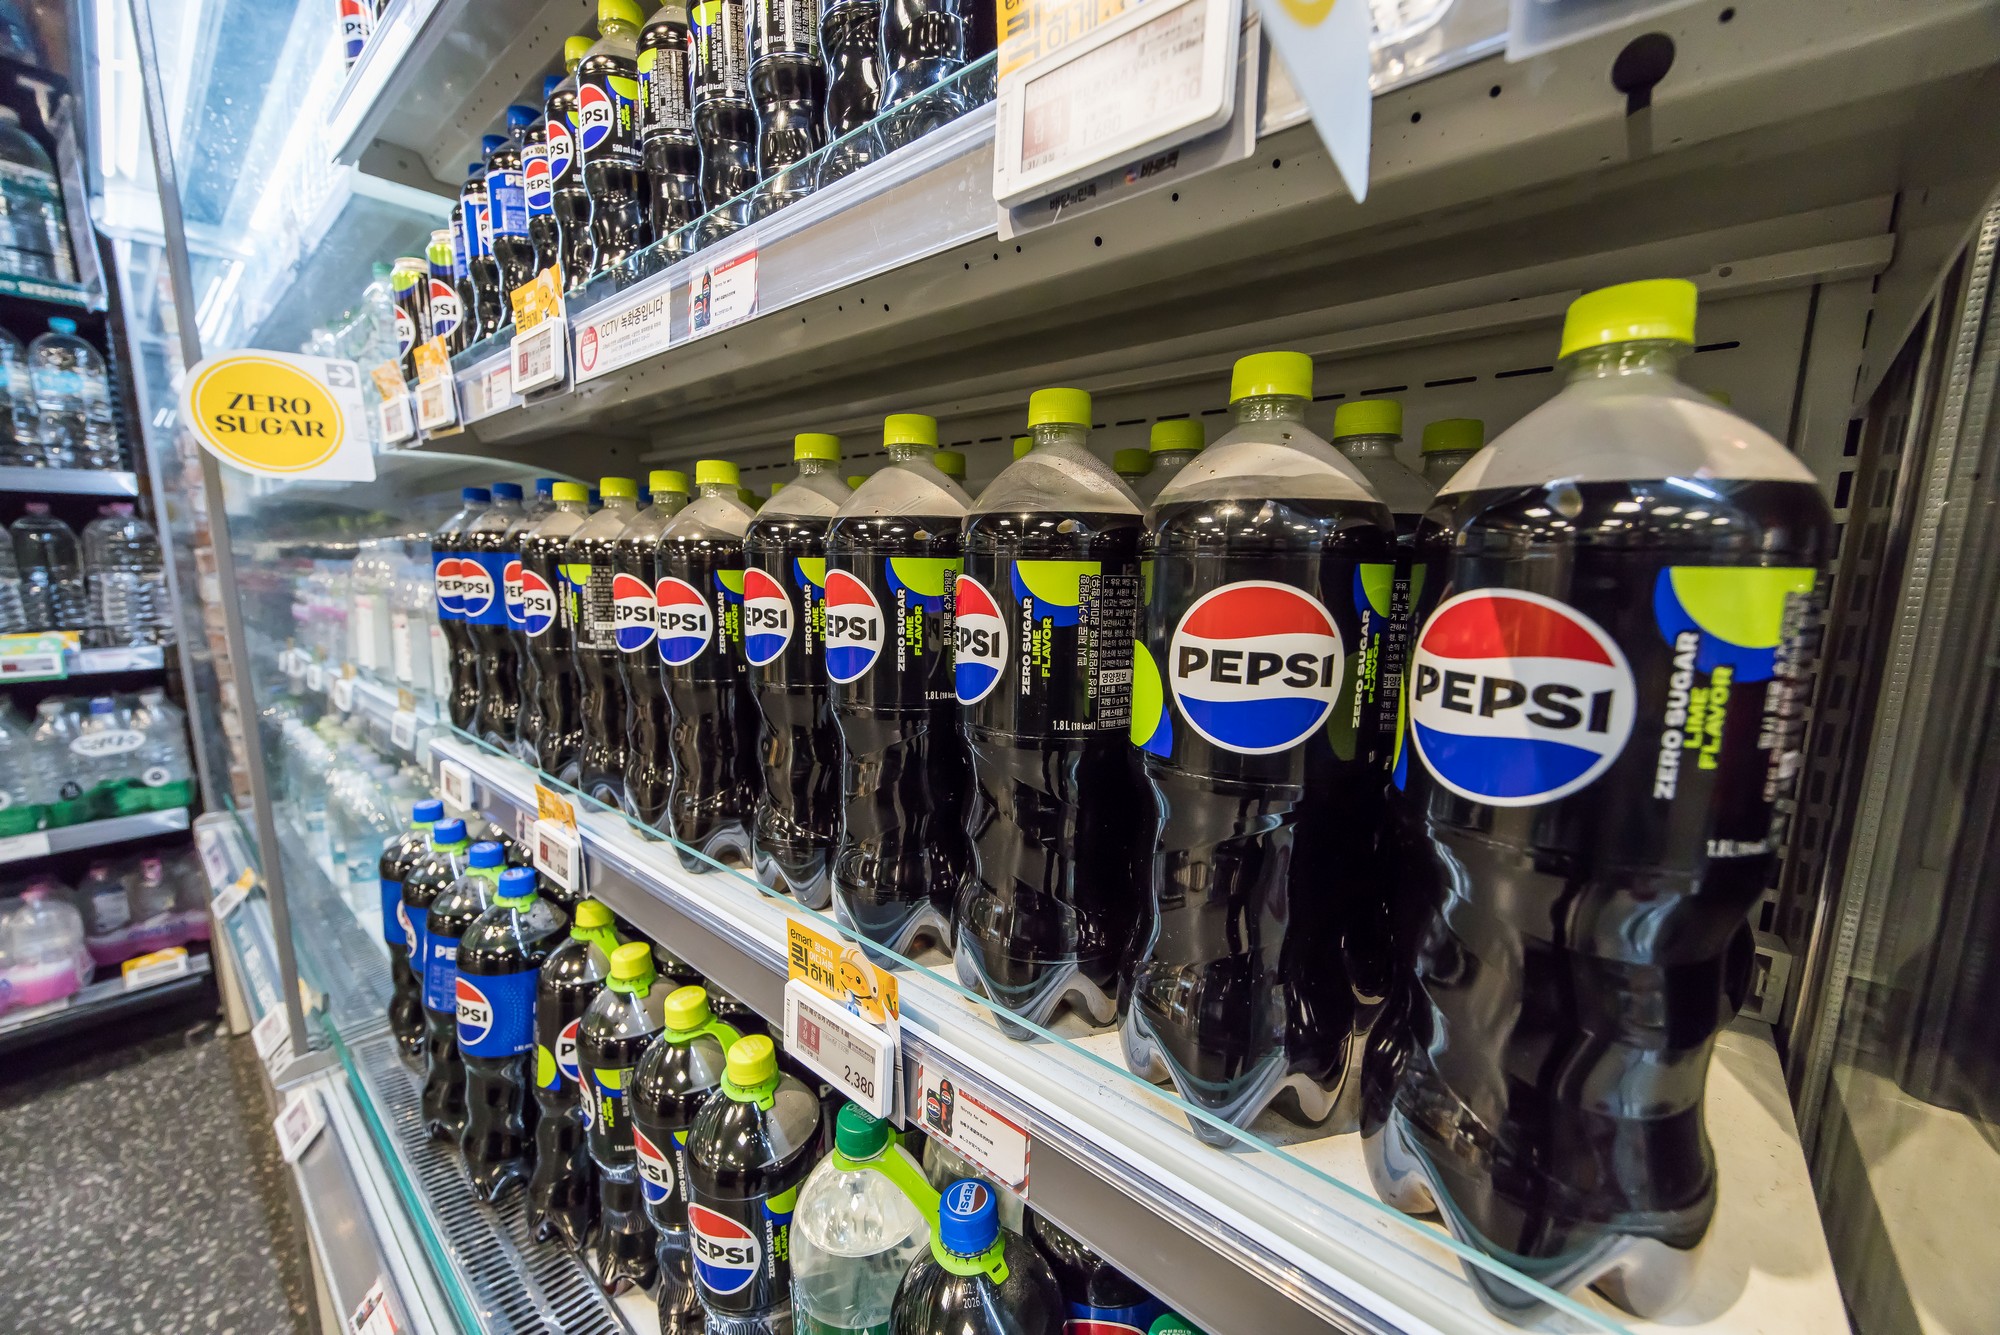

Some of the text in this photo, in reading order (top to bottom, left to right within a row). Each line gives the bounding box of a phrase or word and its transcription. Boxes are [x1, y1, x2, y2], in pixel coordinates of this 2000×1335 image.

[600, 319, 619, 339] CCTV
[620, 296, 664, 330] 녹화중입니다
[226, 391, 311, 416] ZERO
[214, 414, 326, 438] SUGAR
[717, 592, 727, 655] ZERO SUGAR
[724, 611, 733, 635] LIME
[731, 603, 739, 643] FLAVOR
[804, 584, 813, 655] ZERO SUGAR
[897, 589, 907, 672] ZERO SUGAR
[906, 615, 914, 646] LIME
[914, 605, 923, 656] FLAVOR
[1077, 575, 1090, 667] 펩시 제로 슈거 라임향
[1022, 597, 1033, 696] ZERO SUGAR
[1032, 629, 1041, 665] LIME
[1041, 617, 1054, 678] FLAVOR
[1088, 650, 1099, 676] 라임향
[1177, 645, 1335, 688] PEPSI
[1368, 632, 1381, 704] FLAVOR
[1101, 672, 1127, 684] 영양정보
[1101, 685, 1116, 694] 나트륨
[1352, 609, 1371, 729] ZERO SUGAR
[1363, 648, 1373, 691] LIME
[1414, 663, 1614, 734] PEPSI
[1653, 632, 1699, 800] ZERO SUGAR
[1683, 687, 1710, 749] LIME
[1698, 666, 1735, 770] FLAVOR
[1071, 721, 1081, 731] (18
[1081, 721, 1096, 731] kcal)
[790, 928, 813, 949] emart
[675, 1150, 688, 1203] ZERO SUGAR
[959, 1183, 976, 1213] PEPSI
[689, 1224, 755, 1265] PEPSI
[765, 1219, 776, 1279] ZERO SUGAR
[774, 1234, 782, 1258] LIME
[780, 1224, 788, 1262] FLAVOR
